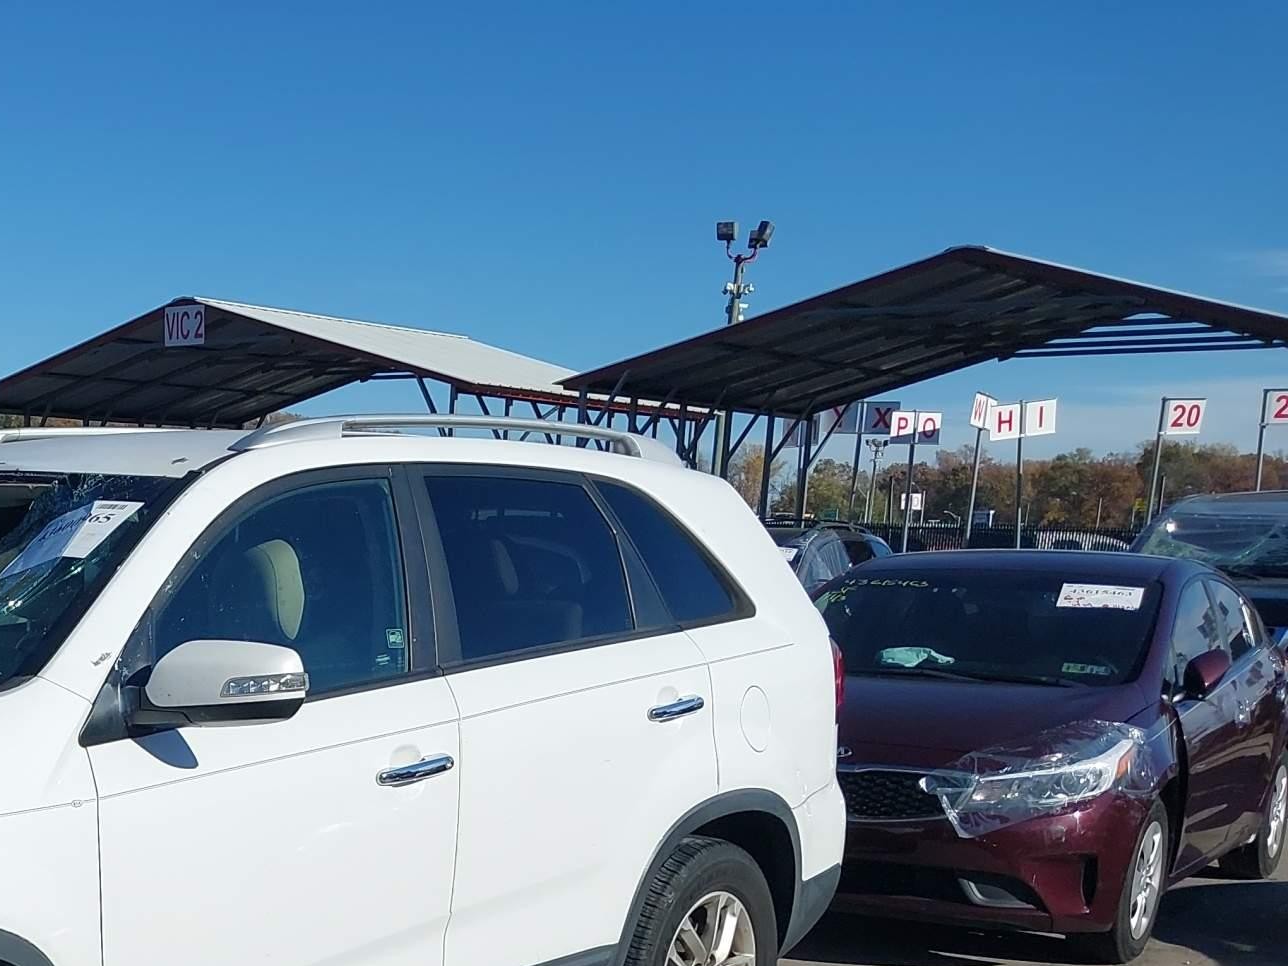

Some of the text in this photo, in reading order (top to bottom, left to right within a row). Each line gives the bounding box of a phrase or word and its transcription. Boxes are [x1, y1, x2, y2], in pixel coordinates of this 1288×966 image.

[166, 310, 204, 341] VIC 2
[871, 407, 894, 429] X
[974, 397, 986, 423] W
[998, 409, 1013, 433] H
[1170, 404, 1202, 428] 20
[896, 416, 909, 438] P
